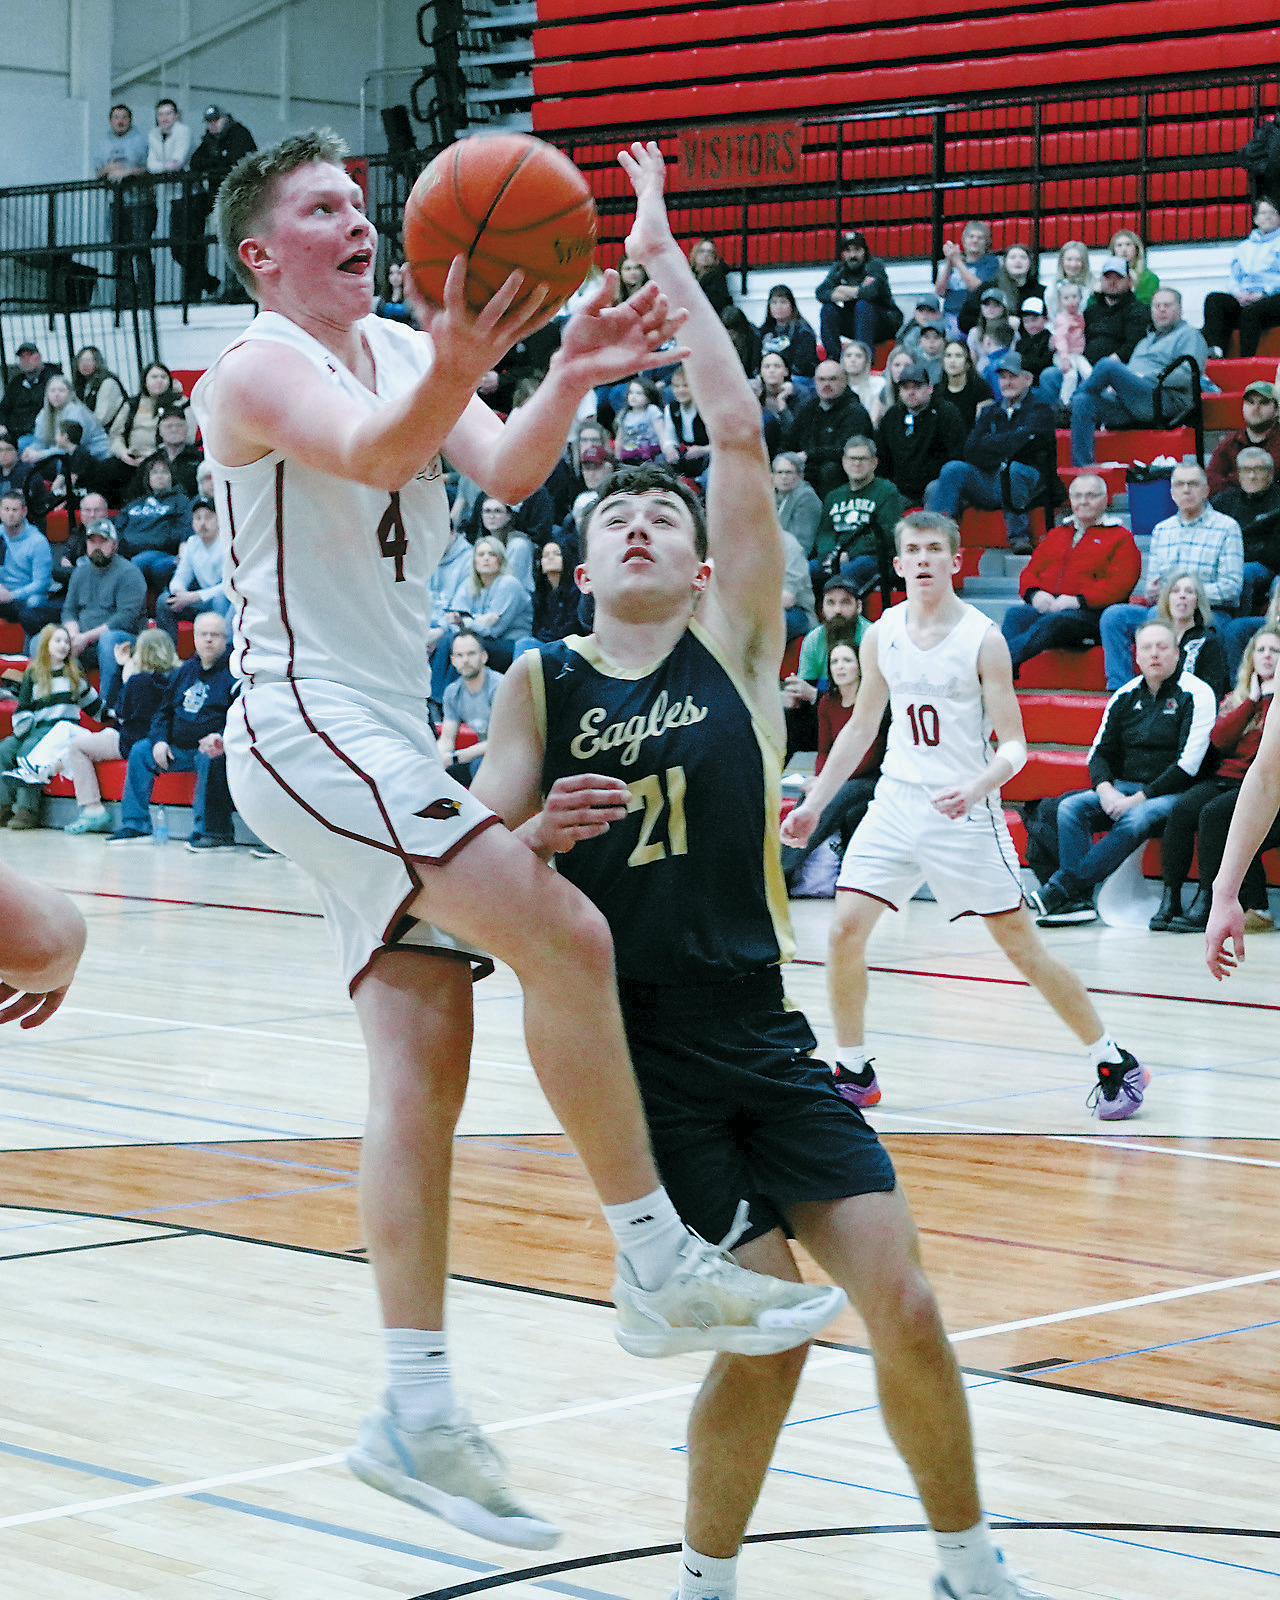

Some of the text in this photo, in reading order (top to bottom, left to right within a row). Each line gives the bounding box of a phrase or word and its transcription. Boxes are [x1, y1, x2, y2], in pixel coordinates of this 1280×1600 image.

[684, 129, 796, 179] VISITORS
[377, 490, 408, 582] 4
[829, 498, 876, 516] ALASKA
[570, 690, 709, 766] Eagles
[907, 704, 940, 747] 10
[627, 765, 689, 867] 21
